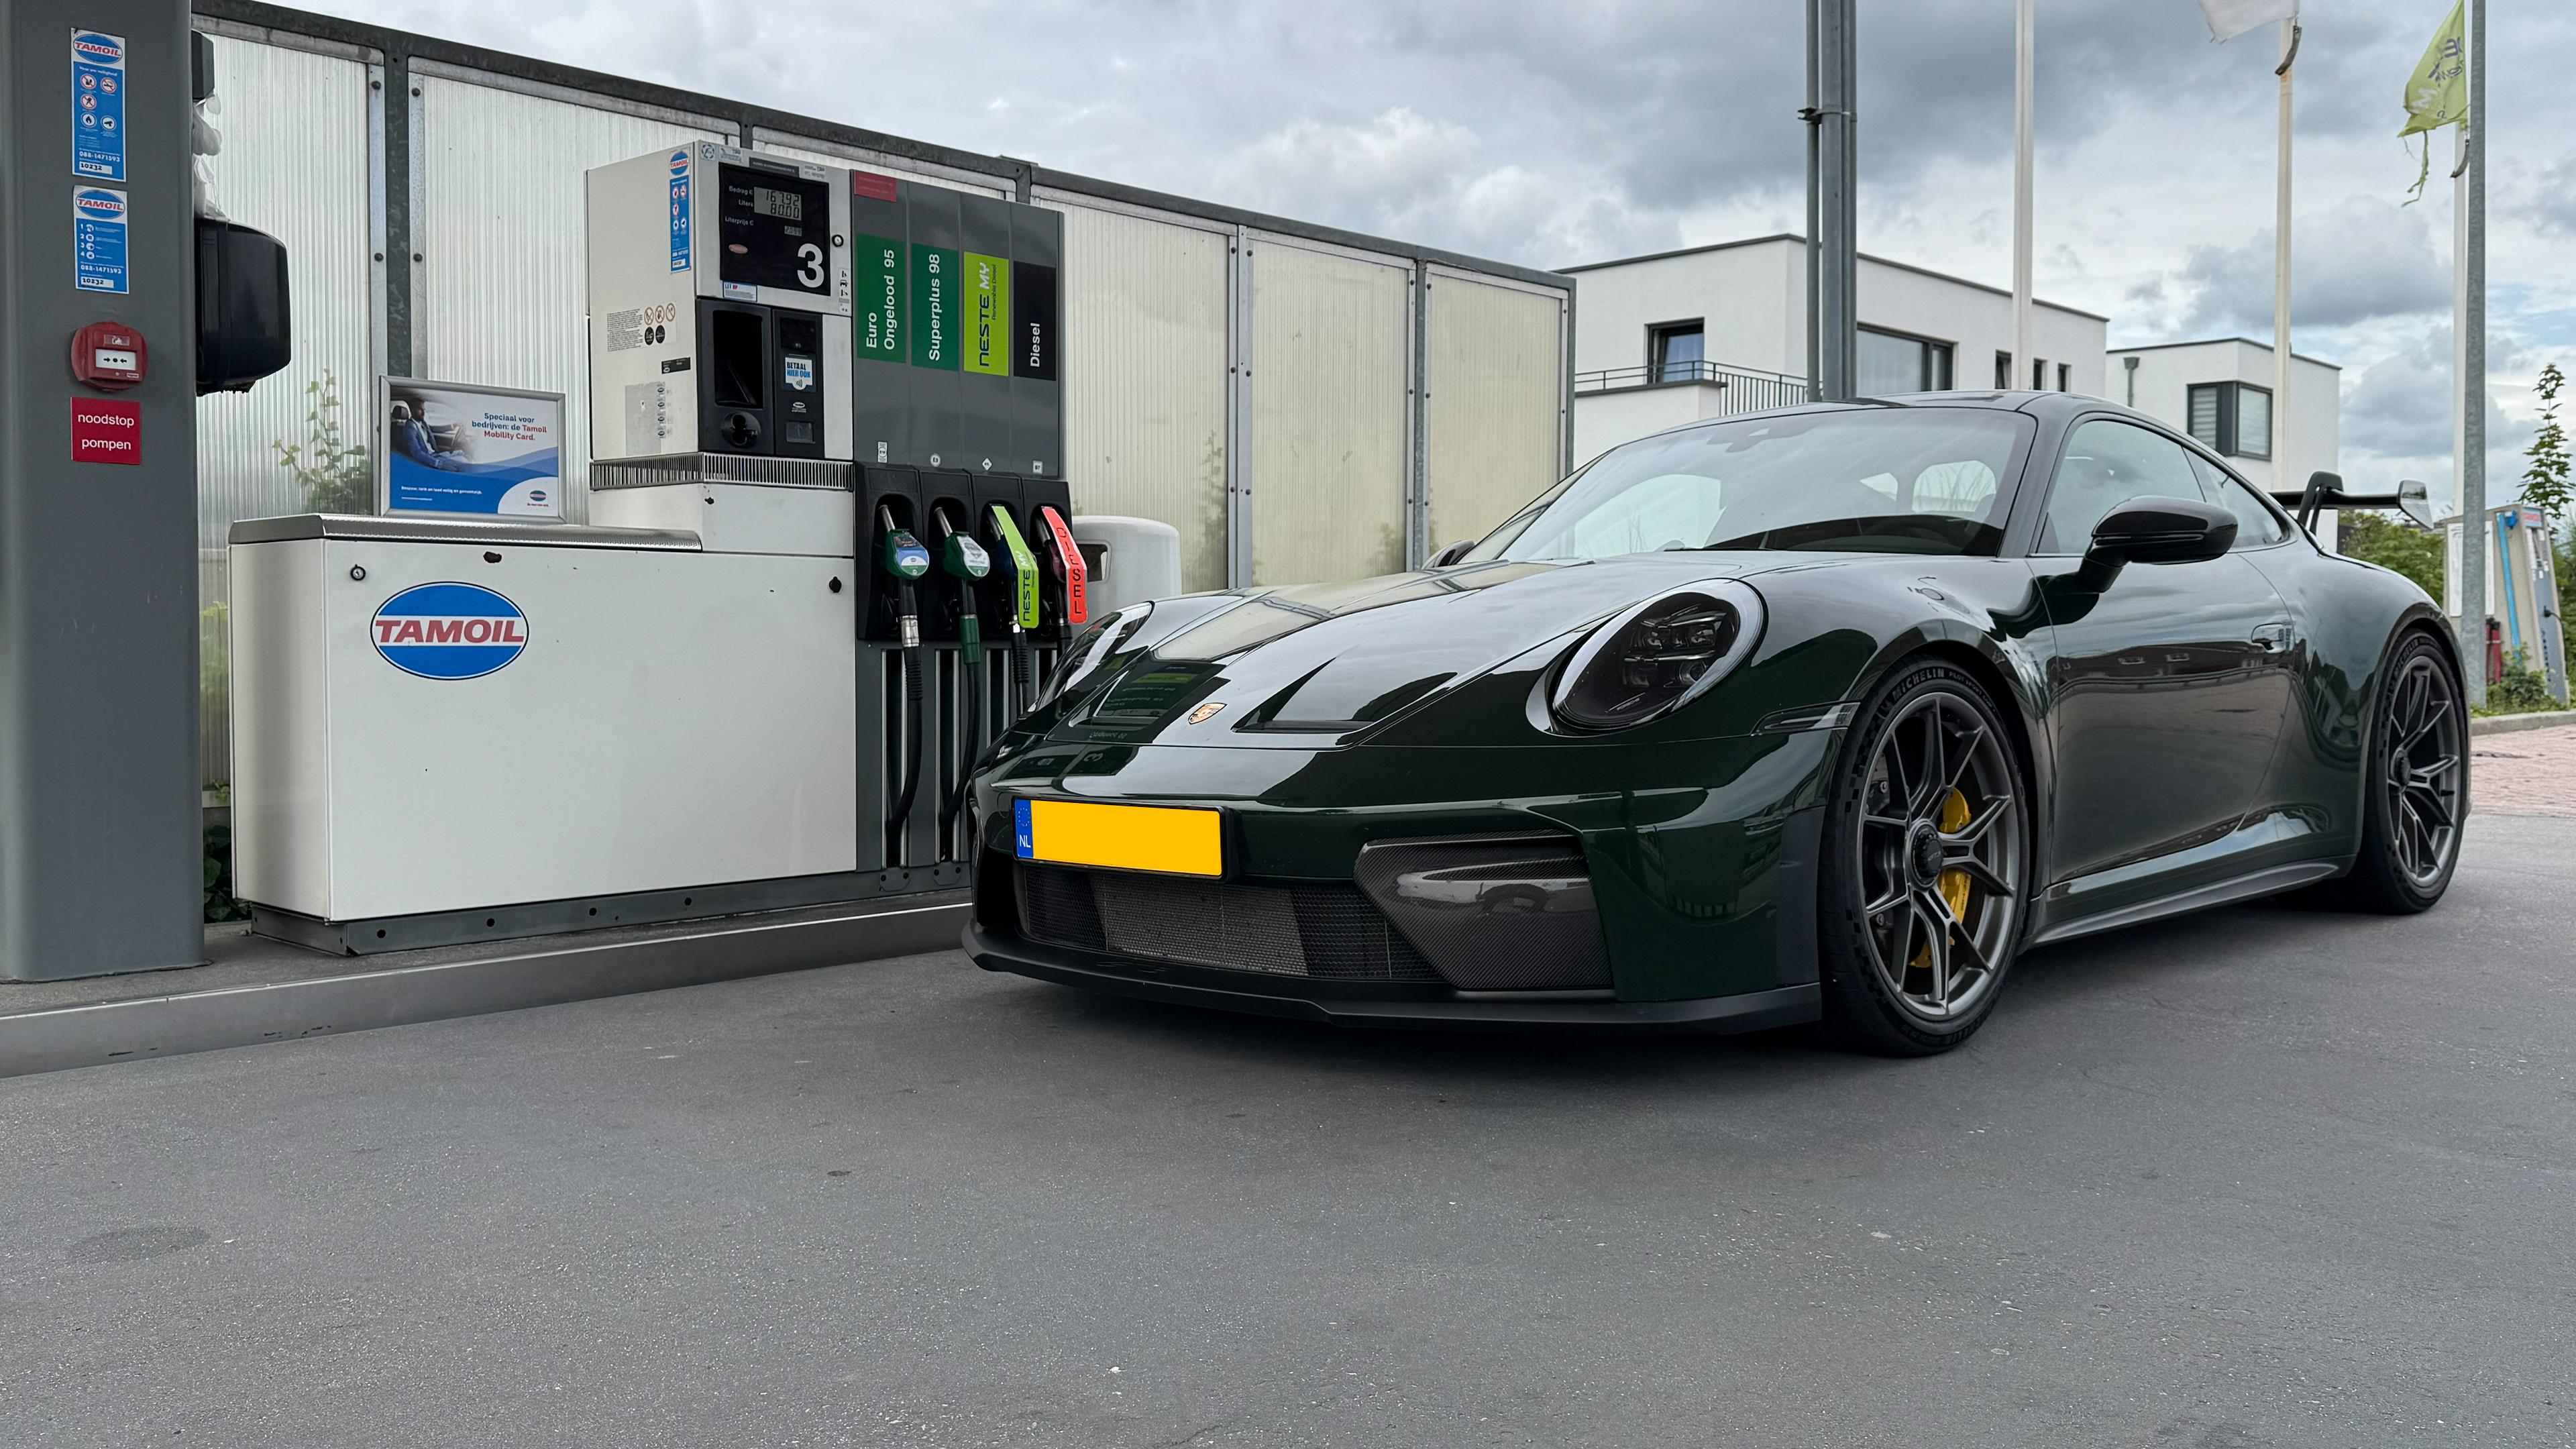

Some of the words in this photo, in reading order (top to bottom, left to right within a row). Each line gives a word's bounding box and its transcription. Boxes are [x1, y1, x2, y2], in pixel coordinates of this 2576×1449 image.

[75, 42, 121, 57] TAMOIL
[80, 162, 103, 170] 10232
[78, 198, 123, 211] TAMOIL
[797, 243, 824, 288] 3
[883, 249, 895, 268] 95
[928, 254, 940, 274] 98
[979, 262, 989, 290] MY
[883, 275, 897, 350] Ongelood
[928, 277, 943, 361] Superplus
[866, 312, 877, 348] Euro
[979, 294, 989, 367] NESTE
[1030, 323, 1040, 368] Diesel
[787, 362, 806, 370] BETAAL
[78, 414, 134, 428] noodstop
[472, 421, 509, 431] bedrijven:
[522, 425, 547, 433] Tamoil
[484, 413, 517, 422] Speciaal
[82, 439, 131, 451] pompen
[484, 431, 514, 441] Mobility
[1057, 527, 1082, 614] DIESEL
[375, 619, 525, 643] TAMOIL
[1892, 668, 1945, 700] MICHELIN
[1019, 834, 1031, 848] NL
